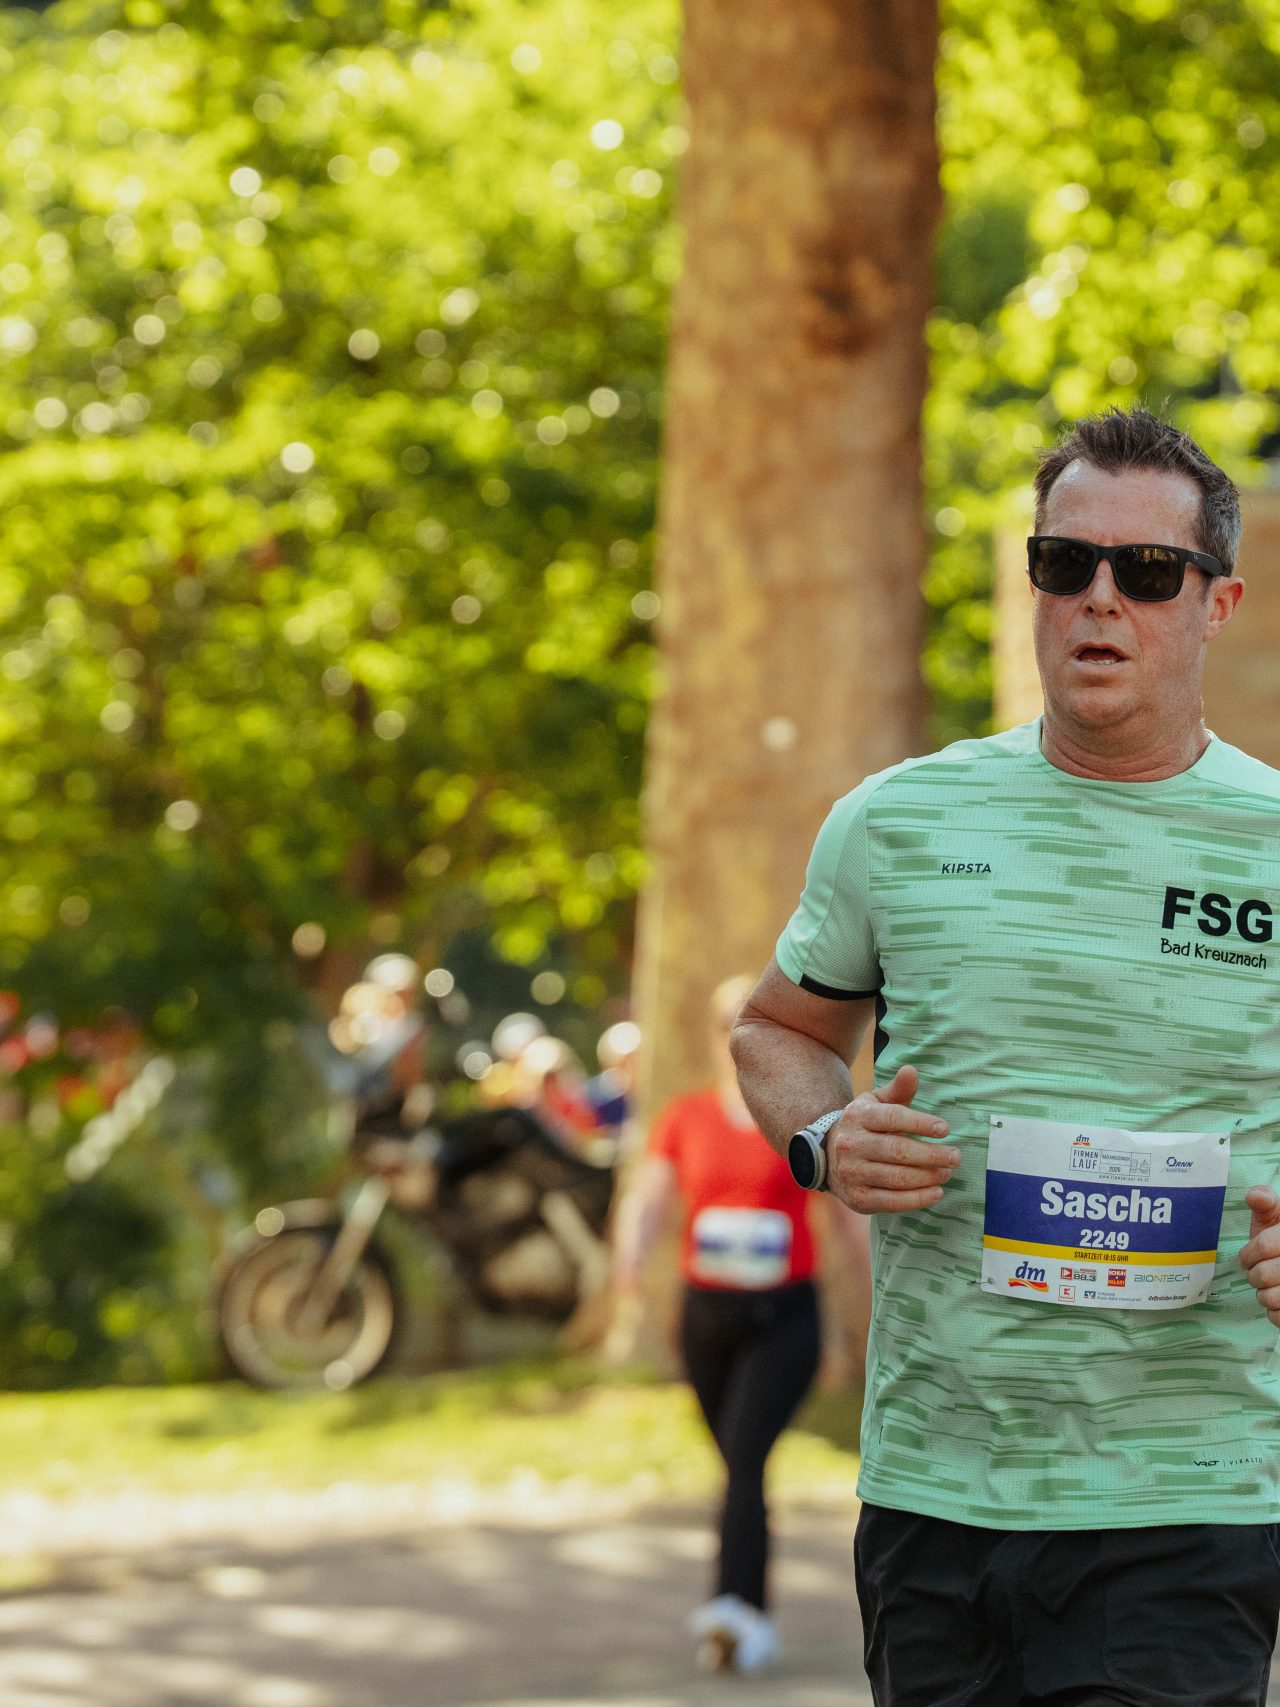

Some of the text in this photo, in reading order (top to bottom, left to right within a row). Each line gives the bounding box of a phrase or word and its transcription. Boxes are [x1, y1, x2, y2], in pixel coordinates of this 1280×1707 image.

[942, 863, 991, 874] KIPSTA
[1161, 886, 1273, 943] FSG
[1160, 938, 1267, 969] Bad Kreuznach
[1076, 1134, 1090, 1142] dm
[1073, 1149, 1099, 1159] FIRMEN
[1072, 1158, 1098, 1170] LAUF
[1040, 1180, 1173, 1224] Sascha
[1079, 1228, 1130, 1250] 2249
[1074, 1251, 1102, 1261] STARTZEIT
[1015, 1261, 1046, 1282] dm
[1073, 1273, 1096, 1282] 88.3
[1134, 1274, 1190, 1283] BIONTECH
